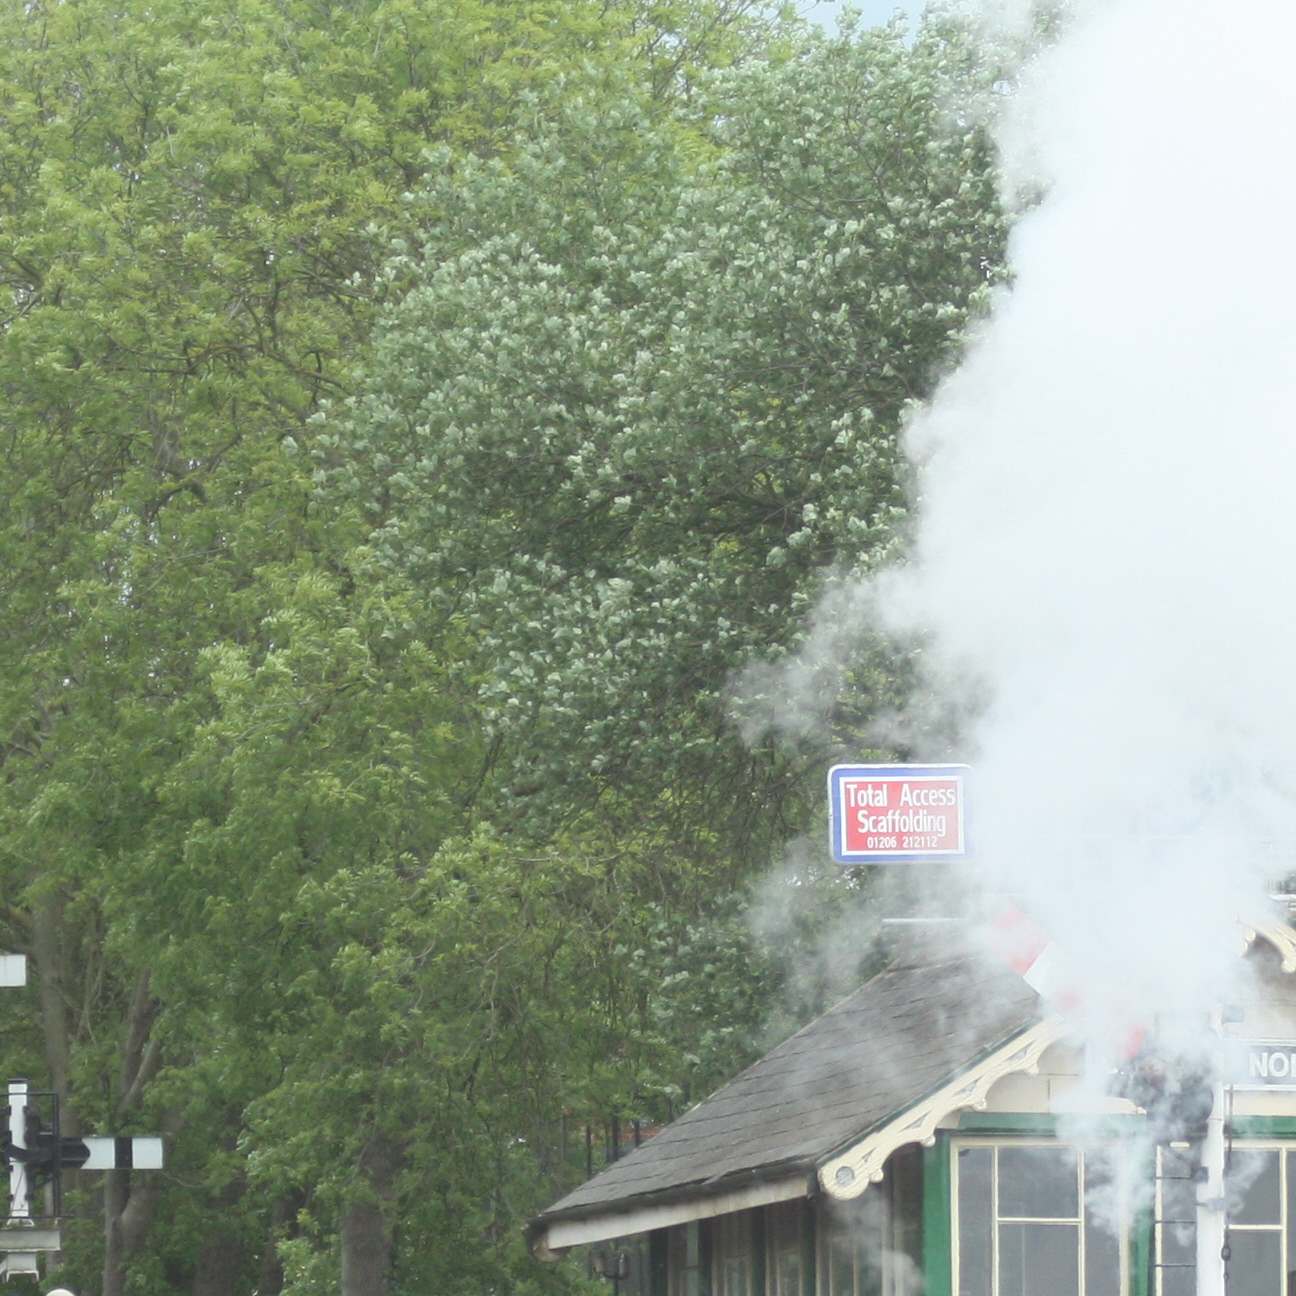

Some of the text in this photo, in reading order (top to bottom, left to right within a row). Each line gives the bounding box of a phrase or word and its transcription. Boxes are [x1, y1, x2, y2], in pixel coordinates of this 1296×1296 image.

[846, 783, 956, 808] Total Access
[857, 810, 946, 837] Scaffolding
[867, 836, 937, 848] 01206 212112
